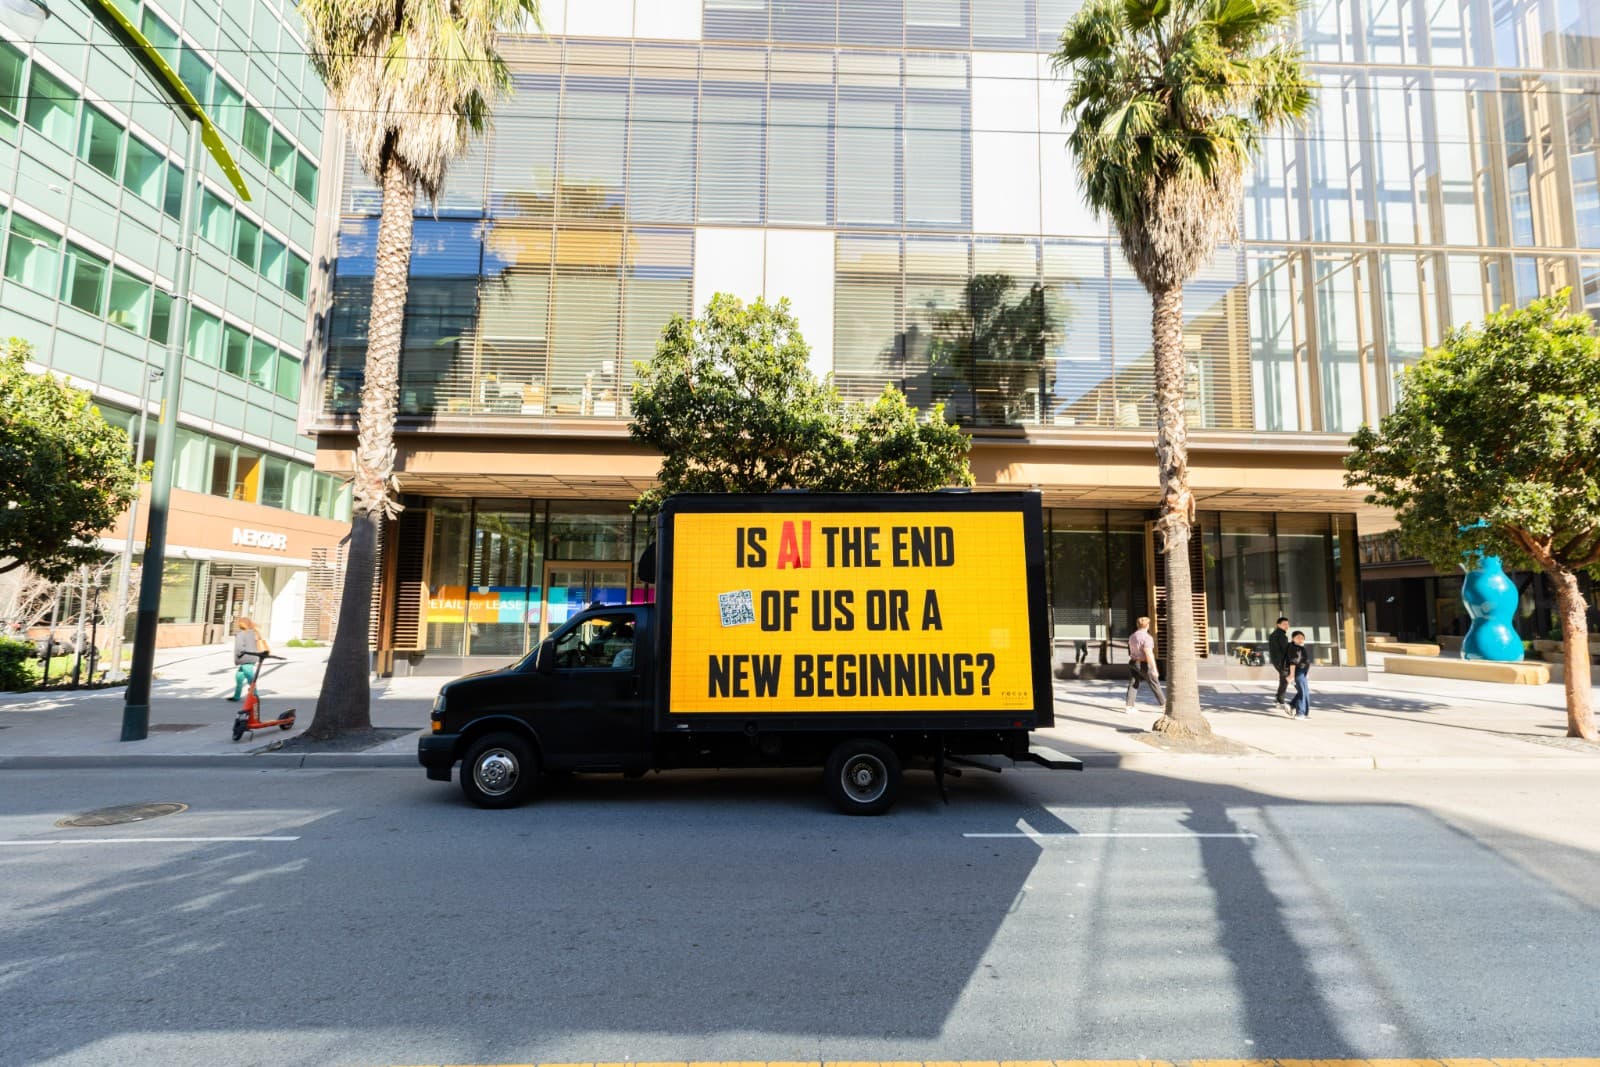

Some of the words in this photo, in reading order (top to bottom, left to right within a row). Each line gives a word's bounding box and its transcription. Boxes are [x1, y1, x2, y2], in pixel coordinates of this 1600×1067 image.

[736, 527, 766, 568] IS
[778, 521, 811, 570] AI
[822, 526, 880, 568] THE
[892, 526, 954, 567] END
[486, 599, 522, 610] LEASE
[761, 591, 800, 632] OF
[811, 590, 854, 631] US
[867, 590, 909, 631] OR
[921, 590, 942, 631] A
[708, 655, 781, 698] NEW
[795, 653, 996, 698] BEGINNING?
